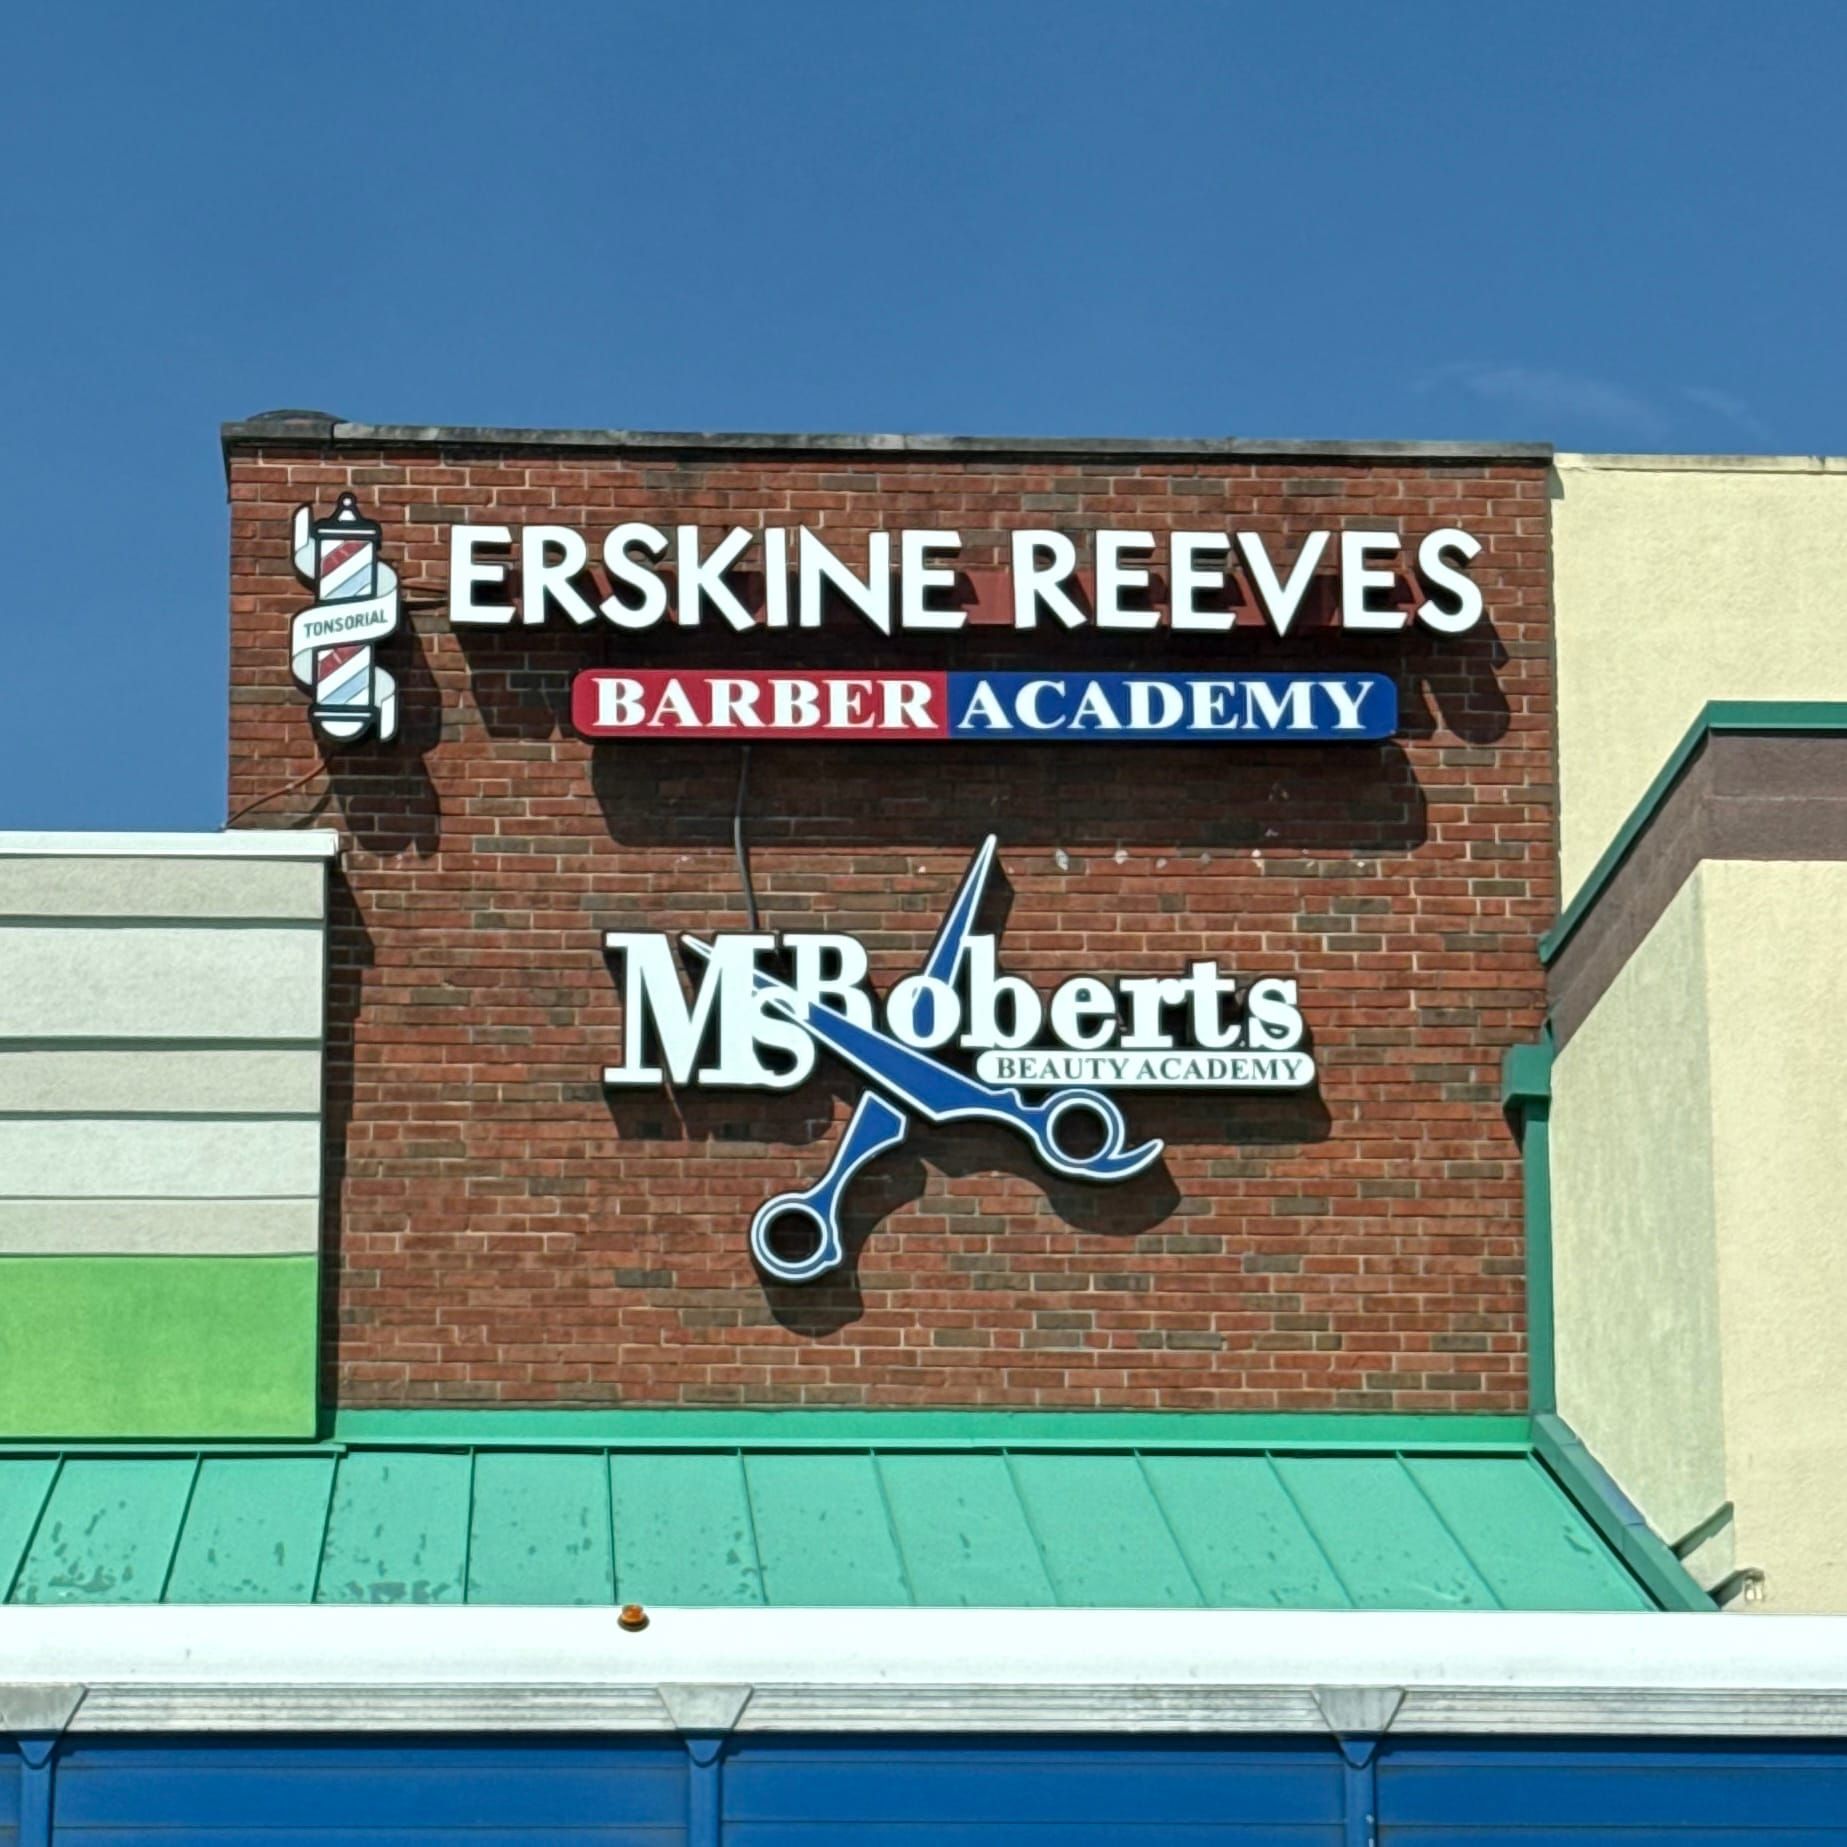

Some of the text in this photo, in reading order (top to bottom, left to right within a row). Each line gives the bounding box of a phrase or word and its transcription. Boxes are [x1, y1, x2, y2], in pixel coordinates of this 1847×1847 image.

[449, 522, 1484, 638] ERSKINE REEVES
[304, 608, 388, 638] TONSORIAL
[592, 676, 1373, 731] BARBER ACADEMY
[996, 1056, 1304, 1081] BEAUTY ACADEMY
